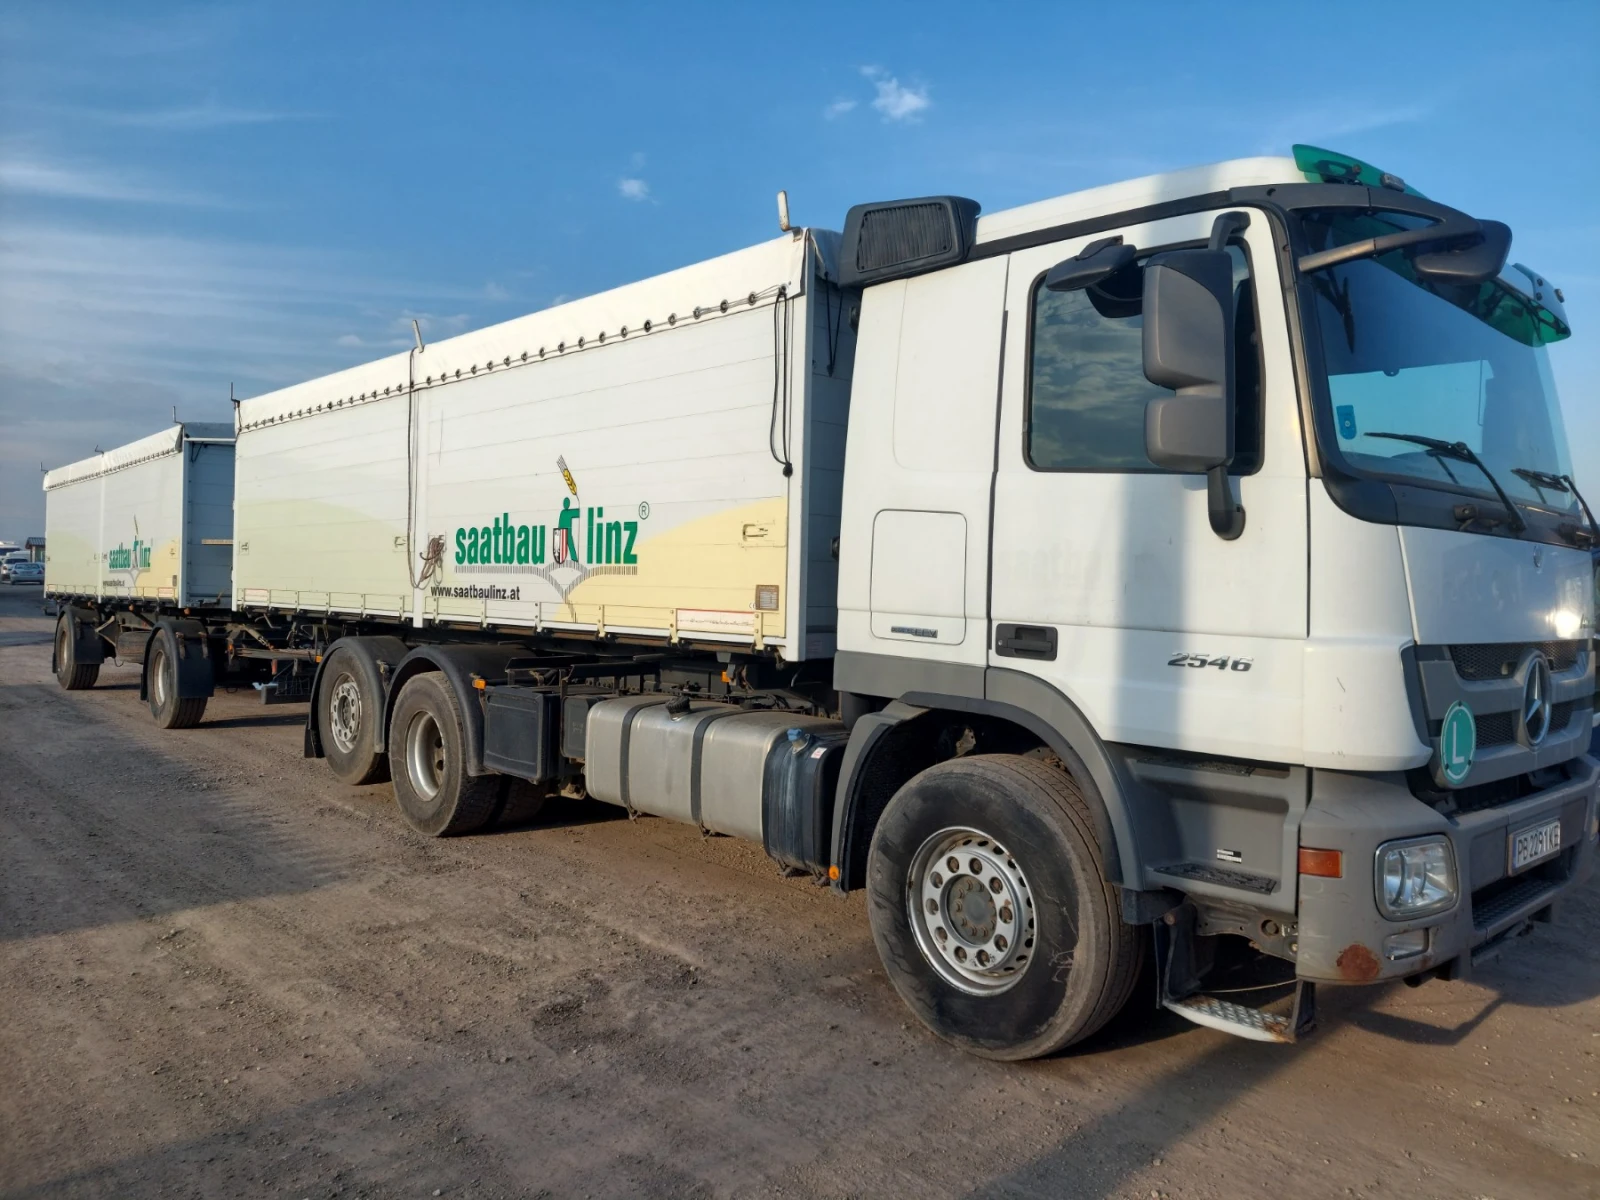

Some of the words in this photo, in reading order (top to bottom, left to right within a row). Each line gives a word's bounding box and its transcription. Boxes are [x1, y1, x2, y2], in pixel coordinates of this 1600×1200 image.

[455, 512, 546, 565] saatbau
[586, 506, 638, 565] linz
[109, 541, 131, 569] saatbau
[139, 539, 151, 568] linz
[430, 584, 521, 601] www.saatbaulinz.at
[1167, 652, 1254, 672] 2546
[1452, 721, 1465, 764] L
